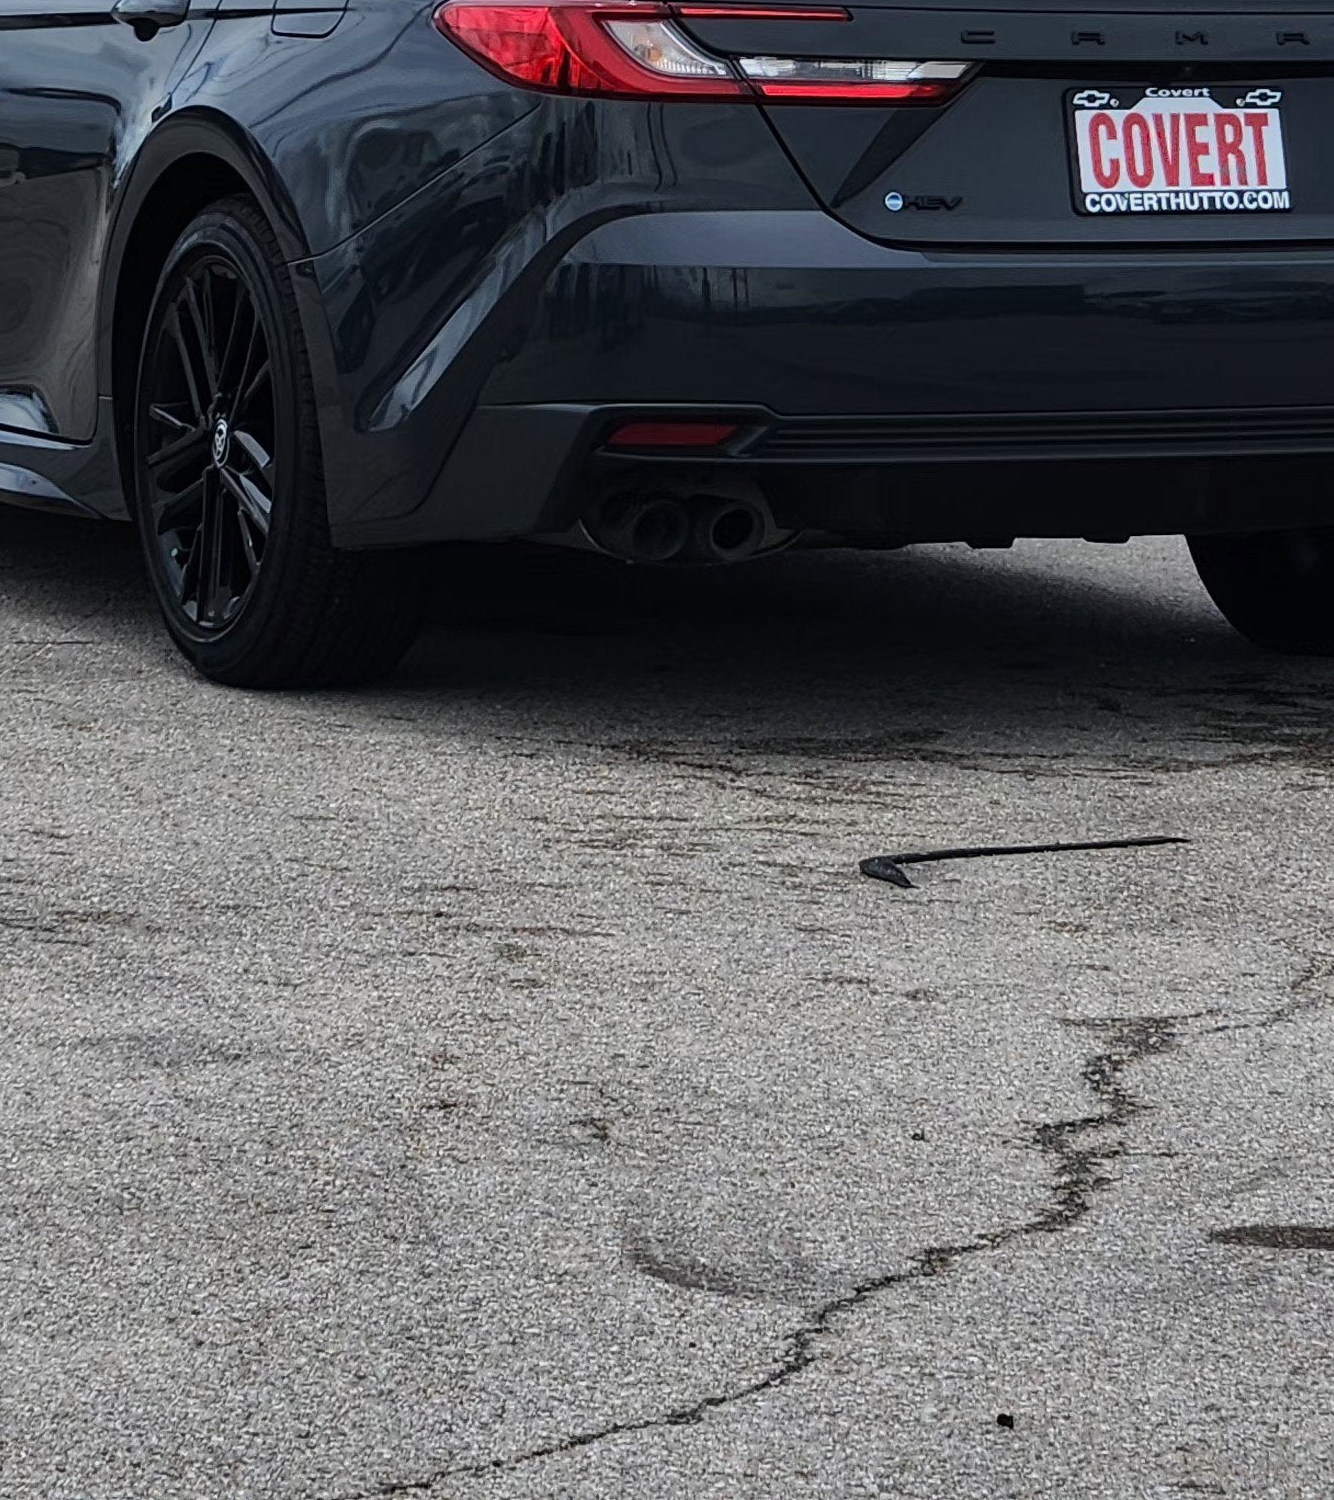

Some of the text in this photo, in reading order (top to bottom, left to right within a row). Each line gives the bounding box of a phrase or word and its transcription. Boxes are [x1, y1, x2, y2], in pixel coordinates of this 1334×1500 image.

[1144, 87, 1211, 98] Covert
[1088, 112, 1269, 189] COVERT
[1085, 190, 1291, 213] COVERTHUTTO.COM
